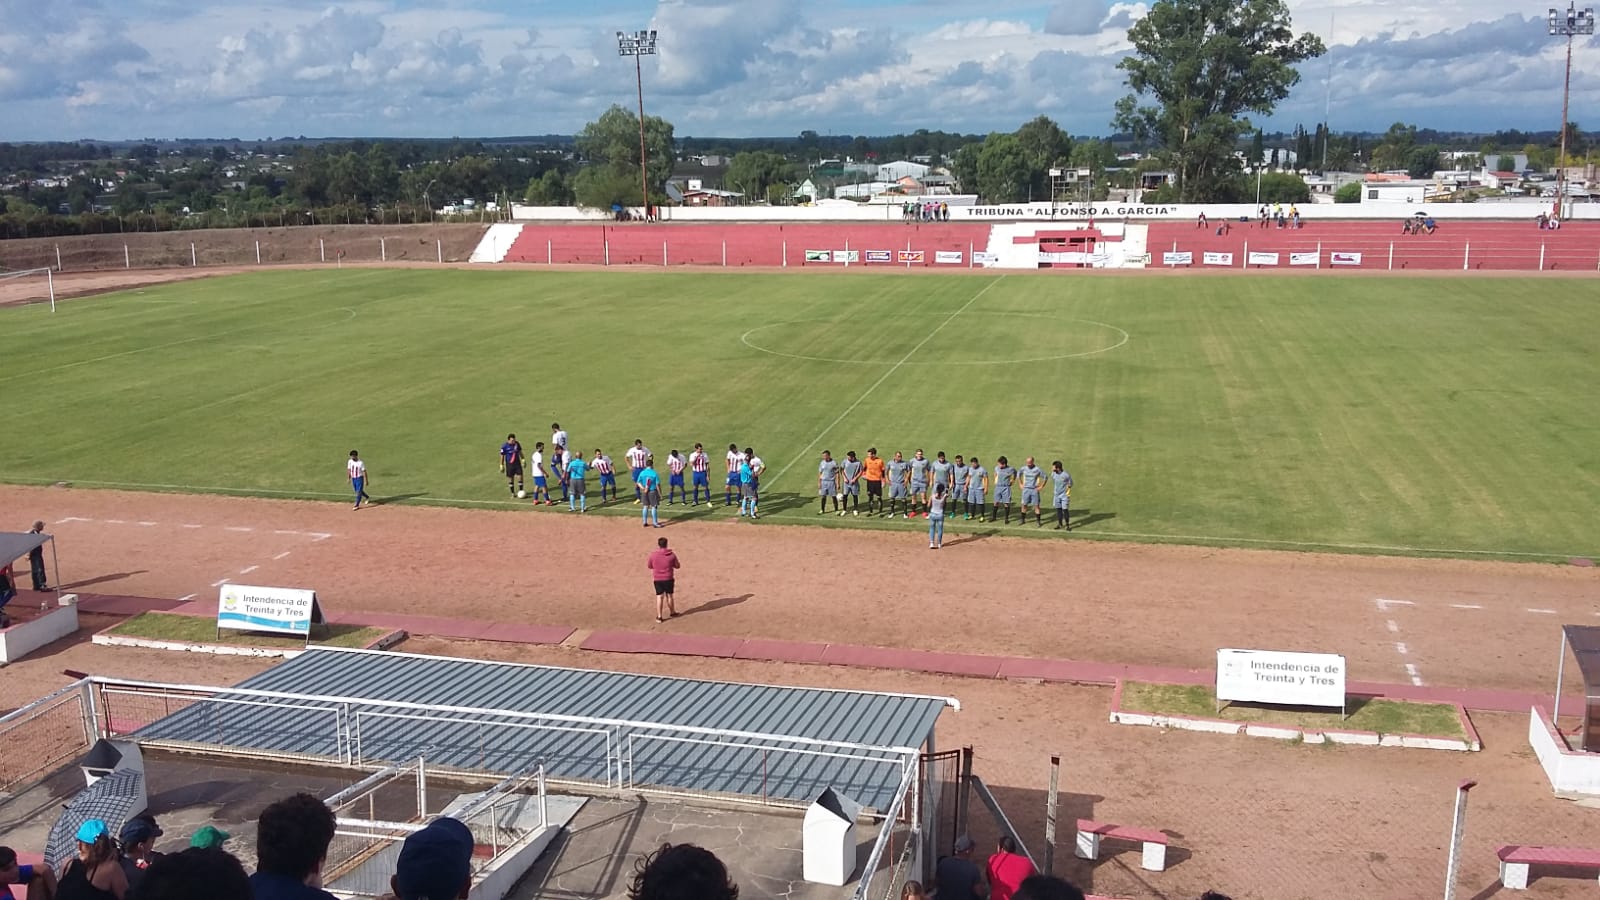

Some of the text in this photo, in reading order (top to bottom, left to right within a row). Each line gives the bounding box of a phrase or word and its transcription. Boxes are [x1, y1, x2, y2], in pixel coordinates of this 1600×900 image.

[967, 207, 1177, 216] TRIBUNA "ALFONSO A. GARCIA"
[243, 594, 308, 606] Intendencia de
[245, 604, 275, 614] Treinta
[285, 607, 304, 616] Tres
[1250, 660, 1339, 674] Intendencia de
[1254, 672, 1336, 686] Treinta y Tres
